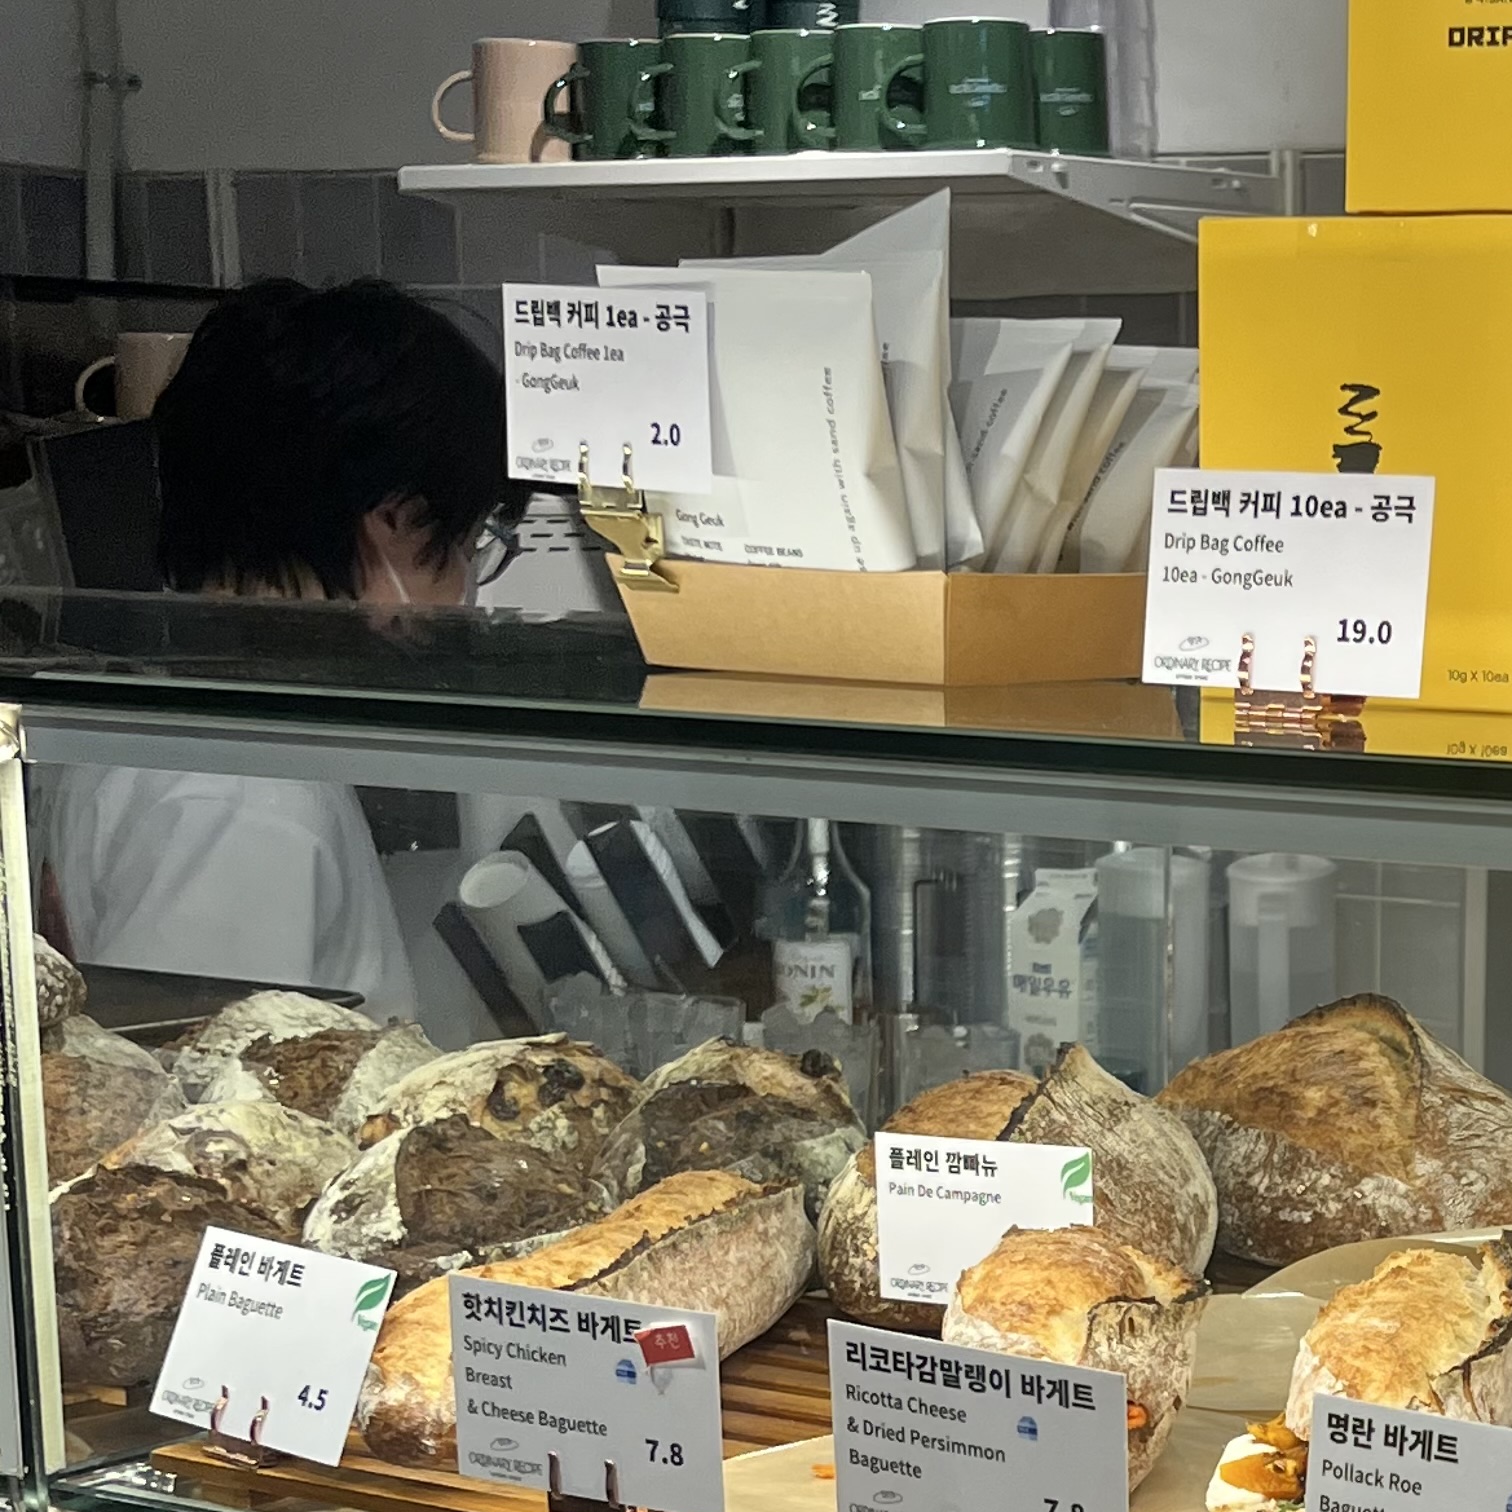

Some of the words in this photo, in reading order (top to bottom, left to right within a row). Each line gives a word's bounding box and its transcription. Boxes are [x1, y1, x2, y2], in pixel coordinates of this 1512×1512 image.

[514, 300, 561, 327] 드립백
[567, 301, 599, 329] 커피
[606, 304, 638, 328] 1ea
[655, 304, 690, 332] 공극
[514, 342, 537, 358] Drip
[540, 343, 561, 362] Bag
[564, 343, 600, 361] Coffee
[604, 346, 624, 362] 1ea
[822, 367, 834, 414] coffee
[651, 423, 680, 446] 2.0
[827, 419, 840, 454] sand
[1168, 489, 1230, 517] 드립백
[1239, 490, 1281, 519] 커피
[1291, 495, 1347, 518] 10ea
[1371, 495, 1416, 523] 공극
[1165, 533, 1195, 554] Drip
[1200, 534, 1229, 555] Bag
[1233, 535, 1284, 553] Coffee
[1163, 566, 1198, 583] 10ea
[1211, 568, 1293, 590] GongGeuk
[1337, 619, 1393, 644] 19.0
[889, 1147, 939, 1172] 플레인
[889, 1182, 914, 1196] Pain
[918, 1185, 933, 1198] De
[936, 1186, 1001, 1206] Campagne
[208, 1243, 256, 1276] 플레인
[257, 1256, 305, 1287] 바게트
[196, 1283, 226, 1303] Plain
[228, 1291, 283, 1320] Baguette
[462, 1292, 570, 1333] 핫치킨치즈
[578, 1311, 642, 1344] 바게트
[464, 1335, 503, 1359] Spicy
[506, 1341, 567, 1367] Chicken
[465, 1367, 512, 1389] Breast
[846, 1341, 1011, 1398] 리코타감말랭이
[1021, 1373, 1096, 1411] 바게트
[298, 1385, 329, 1411] 4.5
[846, 1384, 902, 1410] Ricotta
[907, 1397, 967, 1423] Cheese
[467, 1399, 477, 1415] &
[482, 1401, 534, 1425] Cheese
[538, 1410, 607, 1436] Baguette
[645, 1438, 684, 1466] 7.8
[847, 1417, 859, 1434] &
[863, 1421, 905, 1443] Dried
[910, 1429, 1006, 1462] Persimmon
[1328, 1412, 1375, 1450] 명란
[1384, 1424, 1459, 1464] 바게트
[849, 1448, 922, 1479] Baguette
[1321, 1459, 1384, 1488] Pollack
[1389, 1473, 1422, 1496] Roe
